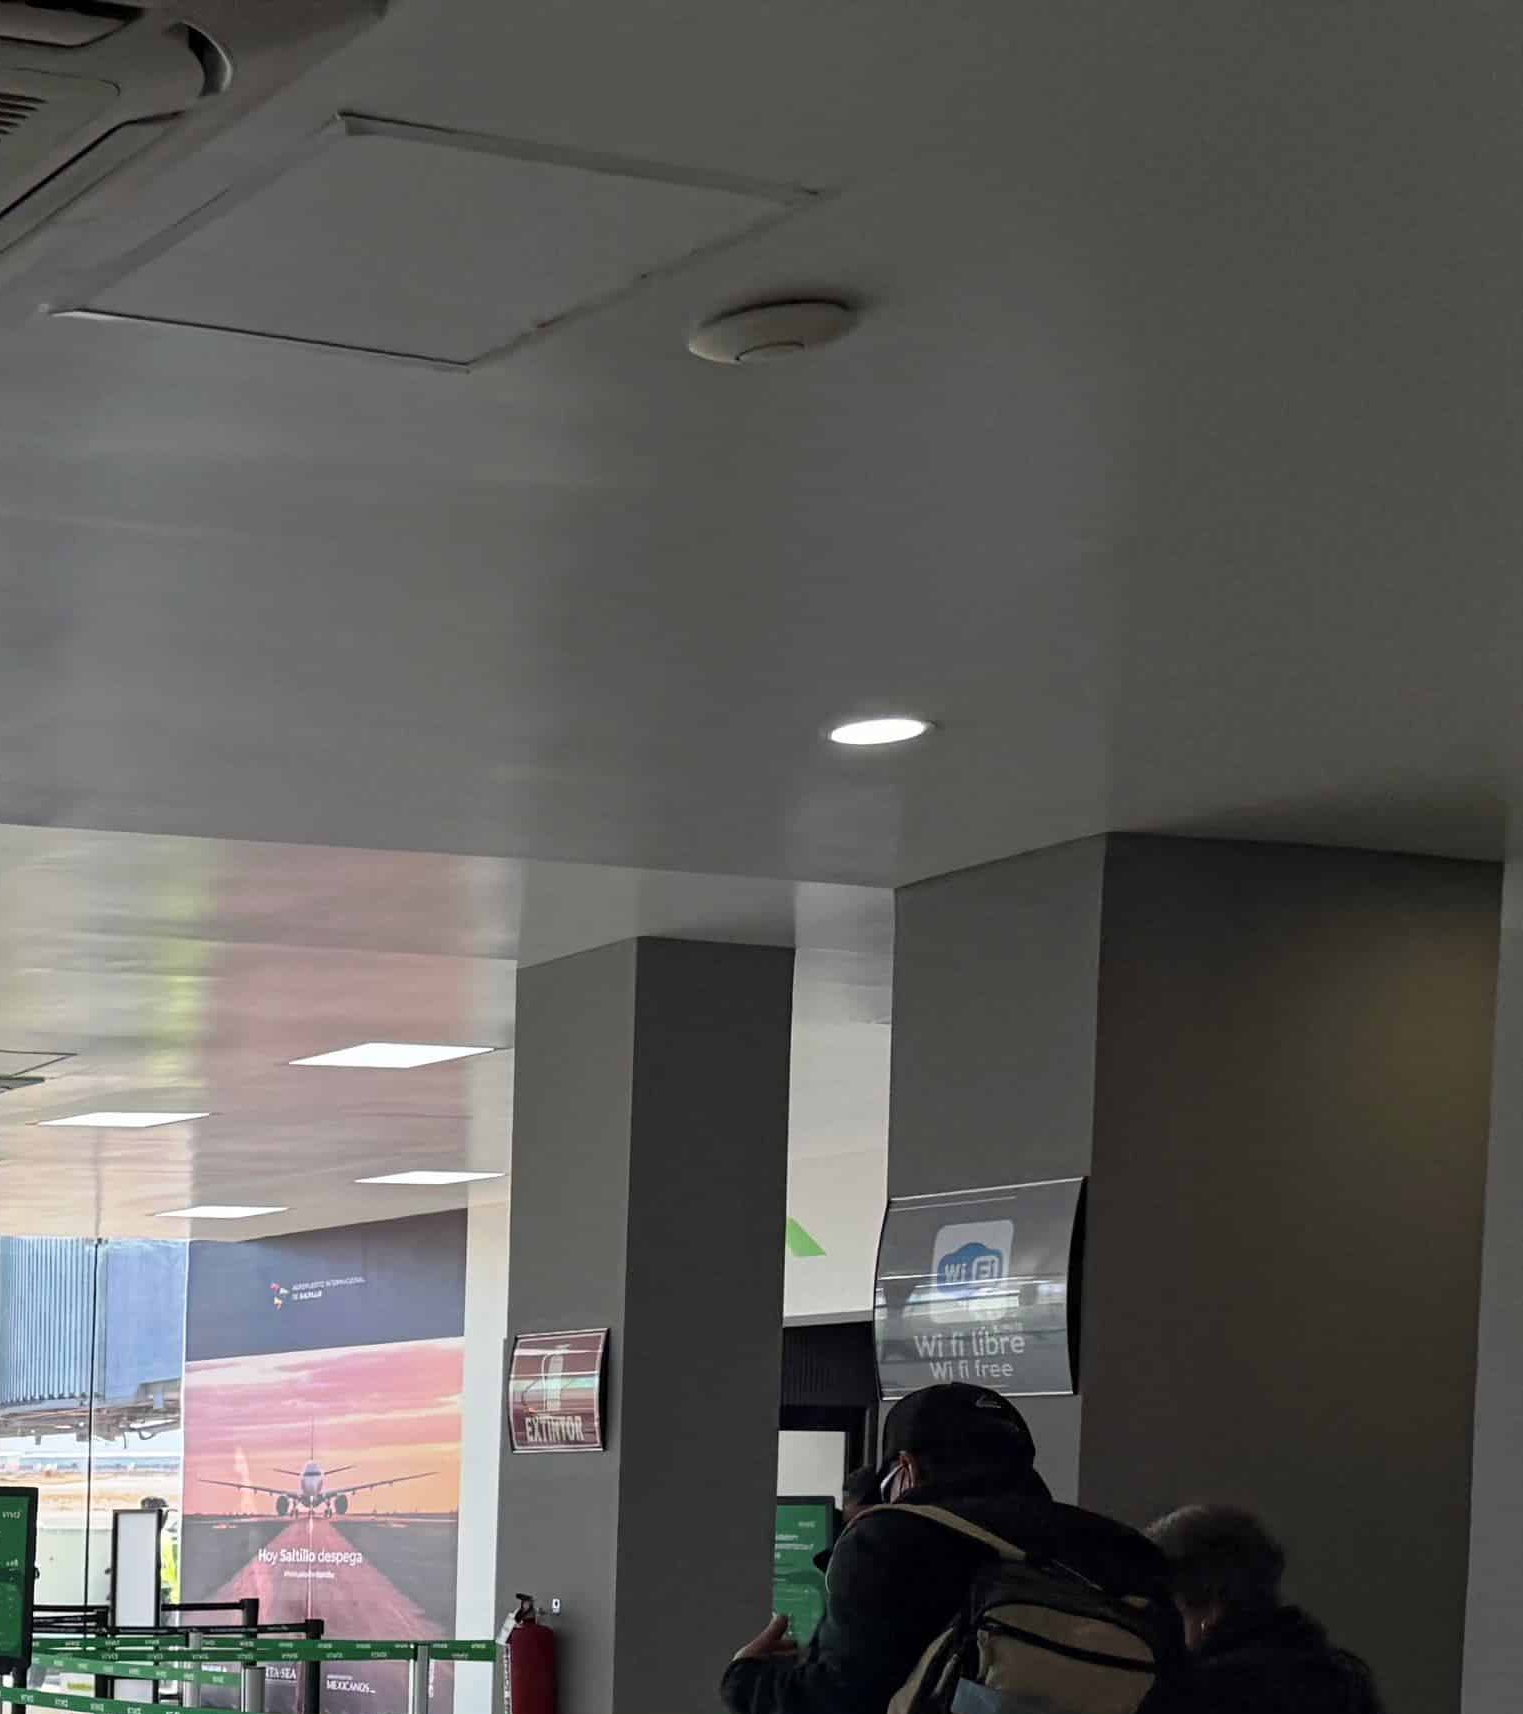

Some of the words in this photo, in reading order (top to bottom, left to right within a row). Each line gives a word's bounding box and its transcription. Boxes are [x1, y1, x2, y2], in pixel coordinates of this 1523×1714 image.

[914, 1334, 942, 1358] Wi
[972, 1327, 1025, 1356] libre
[929, 1361, 953, 1380] Wi
[958, 1359, 970, 1379] fi
[975, 1359, 1014, 1378] free
[525, 1415, 585, 1442] EXTINTOR
[258, 1548, 278, 1565] Hoy
[280, 1548, 316, 1563] Saltillo
[317, 1549, 363, 1566] despega
